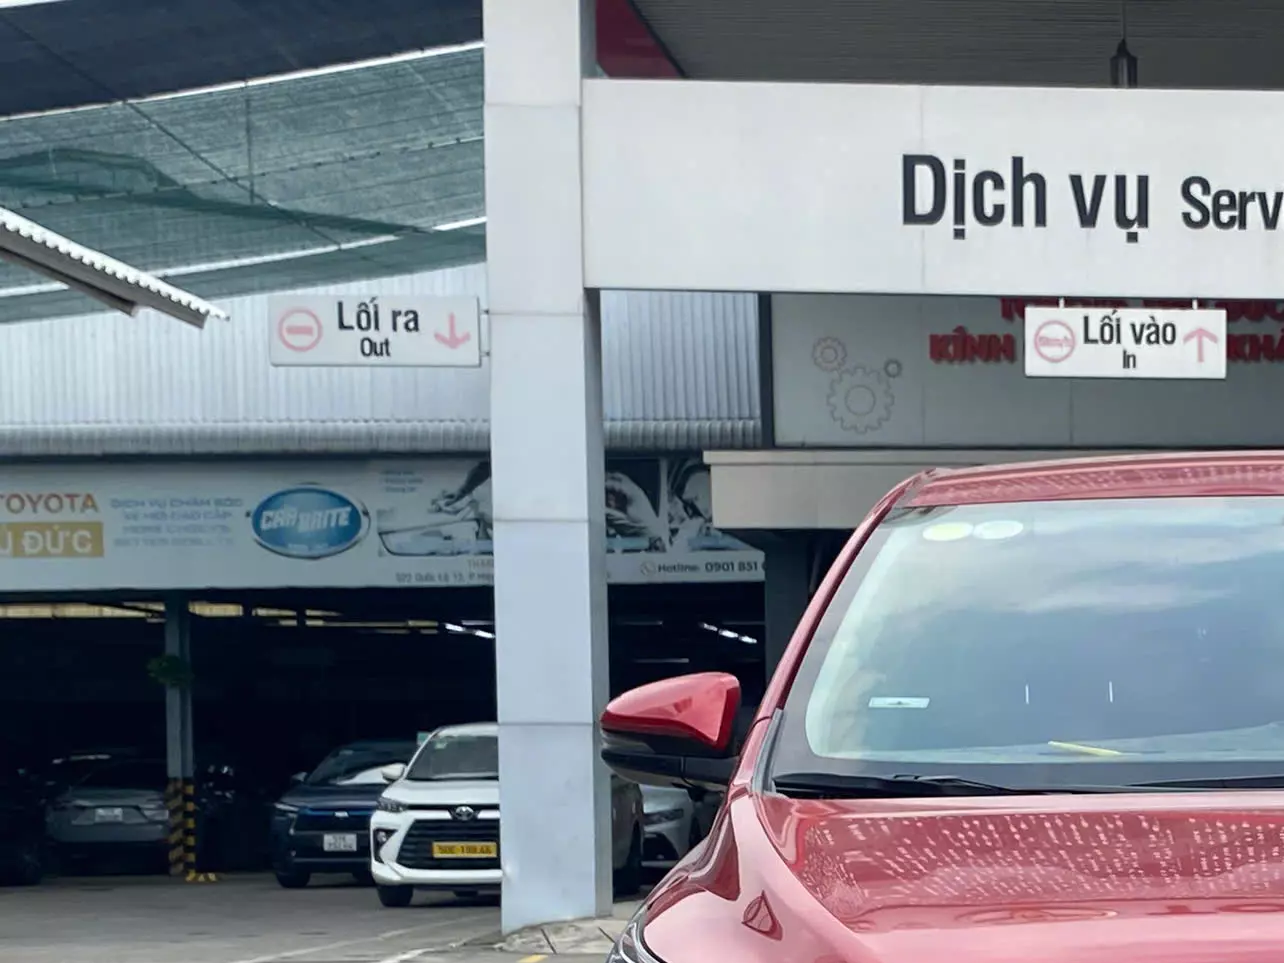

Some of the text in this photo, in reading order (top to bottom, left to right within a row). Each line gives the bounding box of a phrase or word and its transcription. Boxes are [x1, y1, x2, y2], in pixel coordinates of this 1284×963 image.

[902, 153, 1047, 240] Dịch
[1068, 173, 1149, 243] vụ
[337, 297, 419, 332] Lối ra
[1083, 310, 1176, 345] Lối vào
[360, 338, 391, 357] Out
[1122, 350, 1137, 369] In
[21, 524, 92, 554] ĐỨC
[705, 561, 734, 573] 0901
